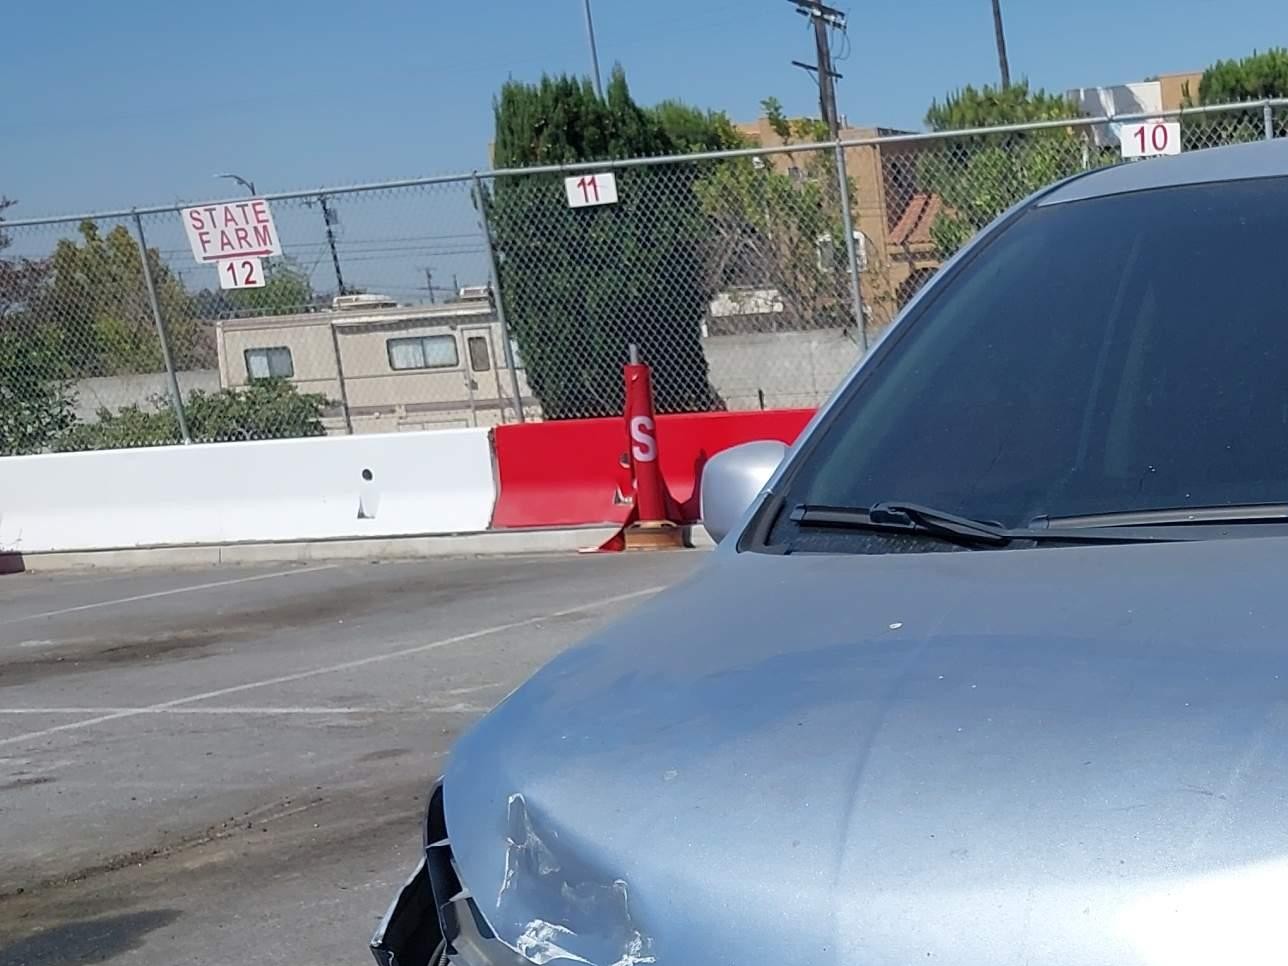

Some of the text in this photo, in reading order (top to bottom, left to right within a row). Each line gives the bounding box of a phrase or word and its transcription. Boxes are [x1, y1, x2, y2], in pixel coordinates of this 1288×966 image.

[1134, 124, 1168, 154] 10
[577, 175, 600, 203] 11
[189, 201, 270, 231] STATE
[199, 224, 273, 253] FARM
[226, 261, 257, 287] 12
[630, 416, 657, 463] S
